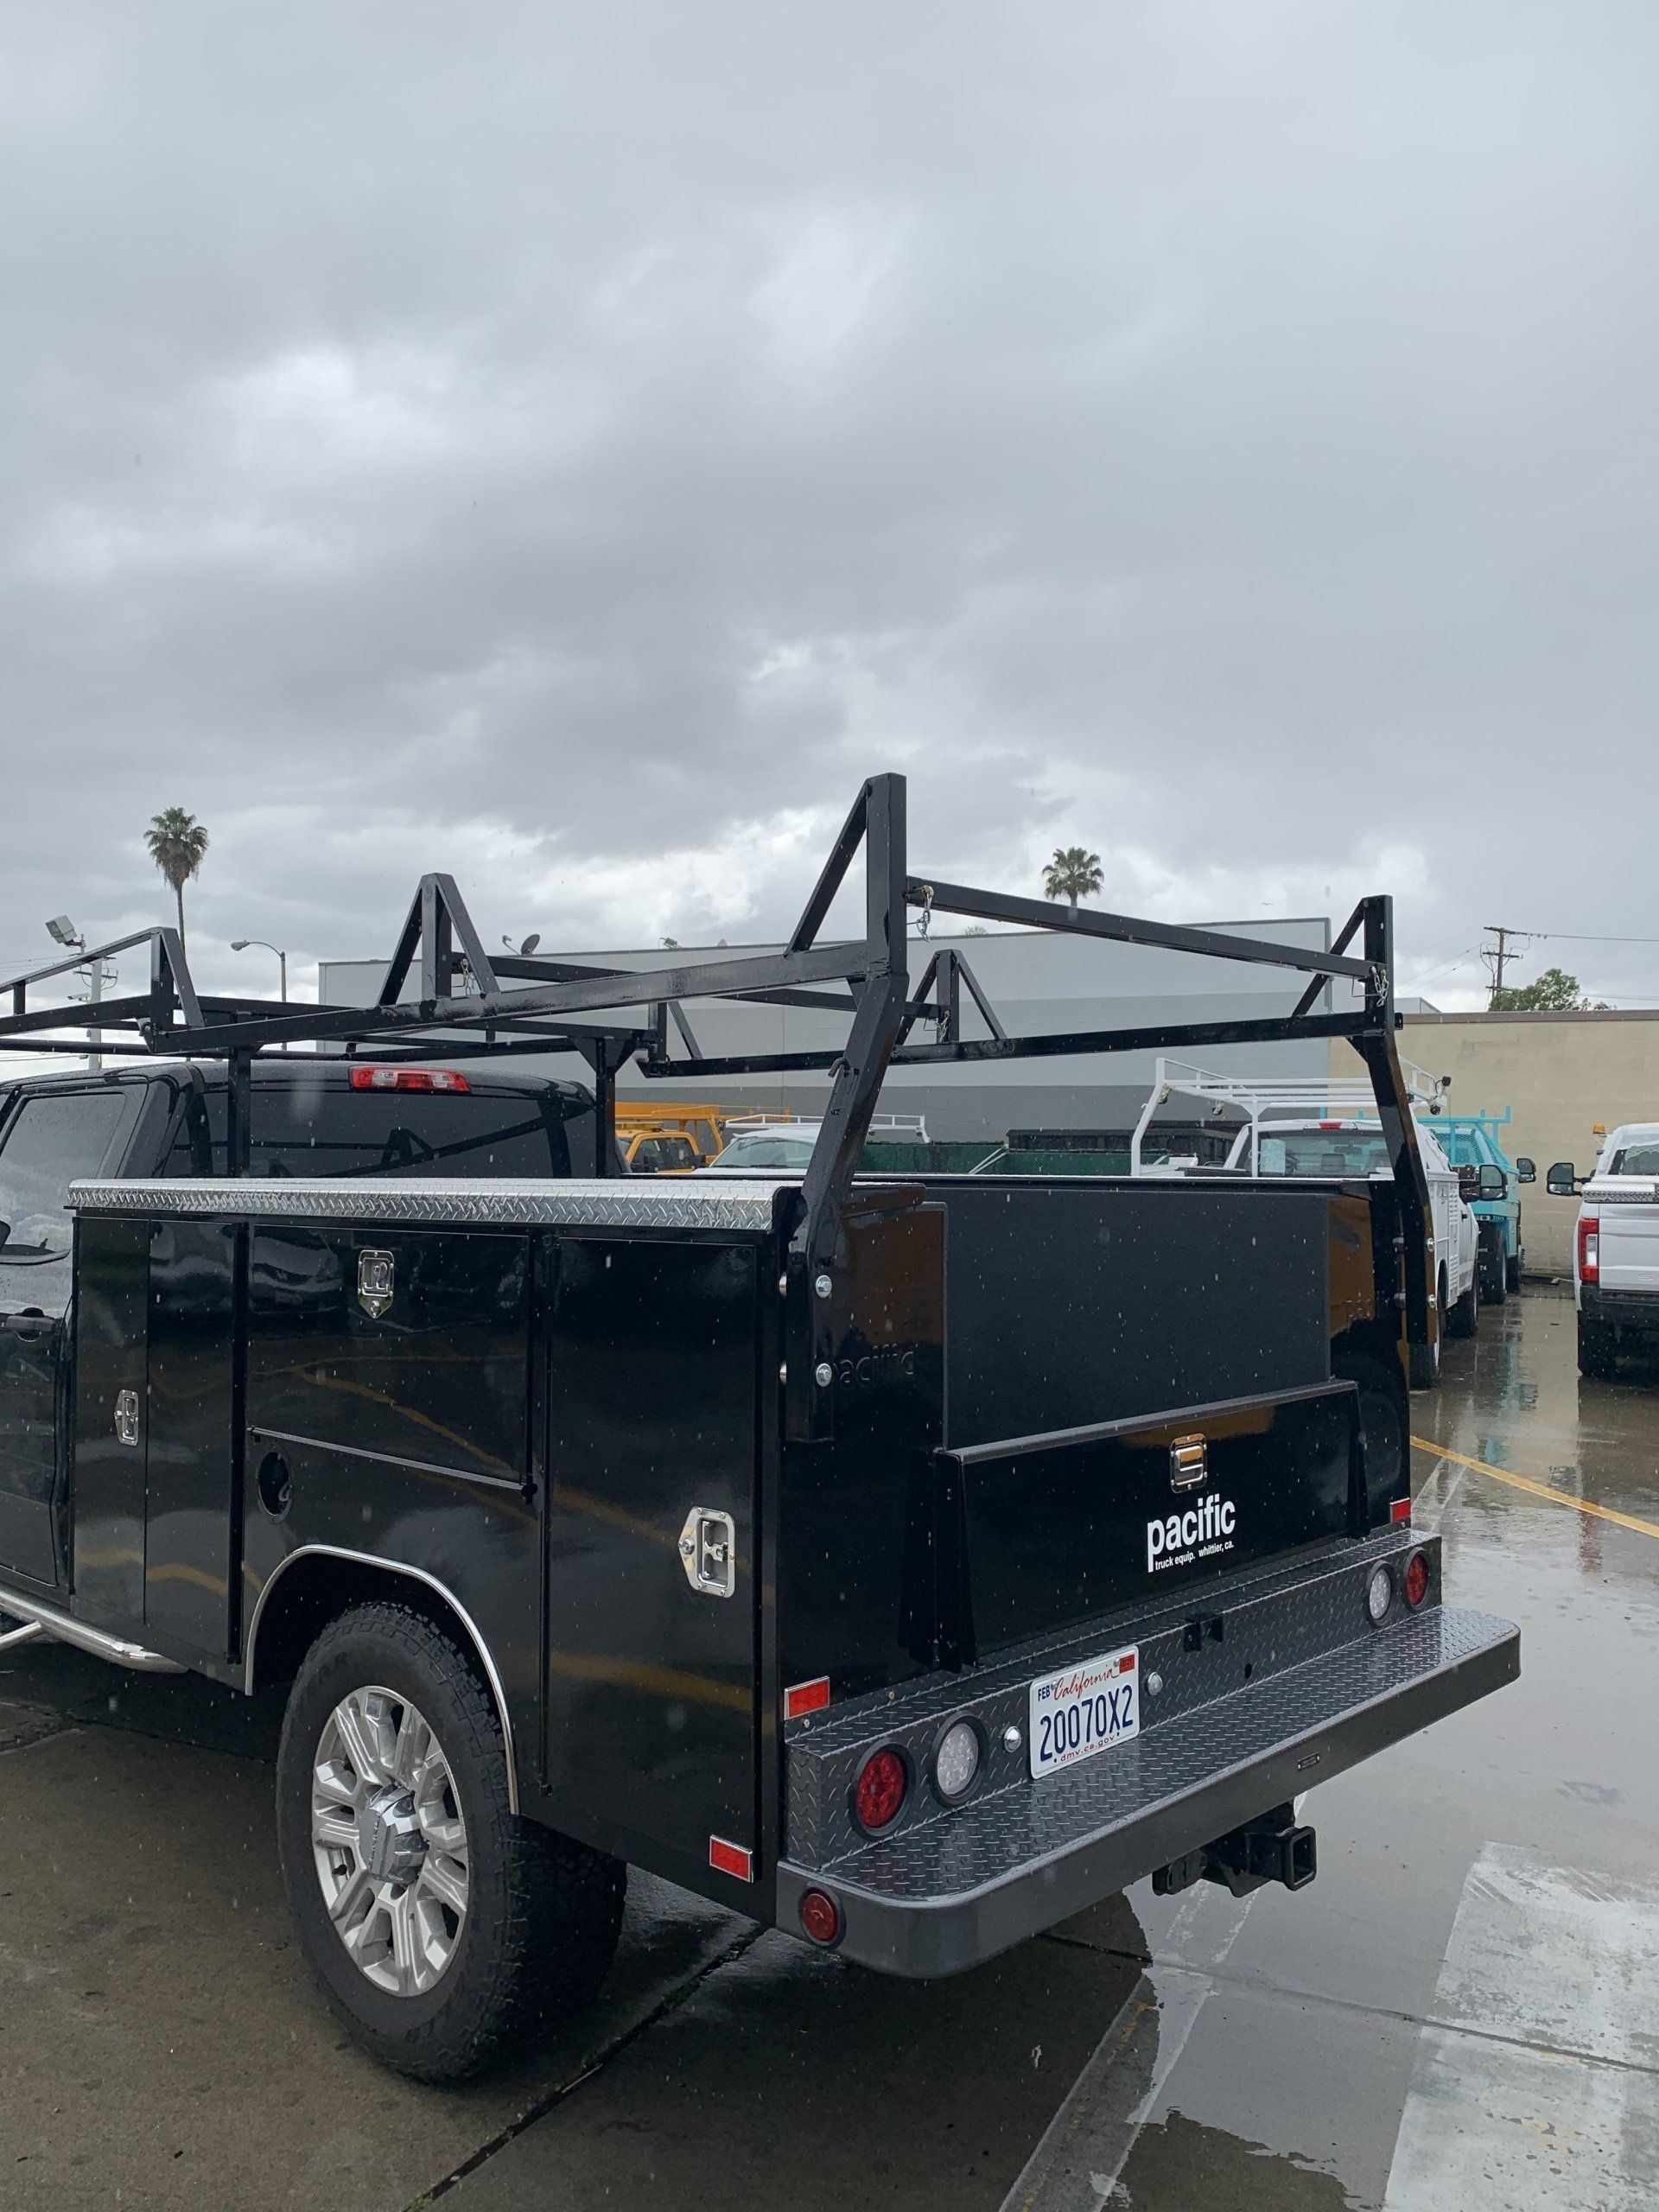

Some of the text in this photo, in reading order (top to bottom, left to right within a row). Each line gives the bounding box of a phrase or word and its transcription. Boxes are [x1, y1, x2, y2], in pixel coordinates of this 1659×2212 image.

[1147, 1493, 1236, 1573] pacific
[1155, 1541, 1234, 1570] truck equip. whittier, ca.
[1038, 1666, 1120, 1701] FEB California
[1040, 1684, 1133, 1762] 20070X2
[1060, 1734, 1115, 1762] dmv.ca.gov
